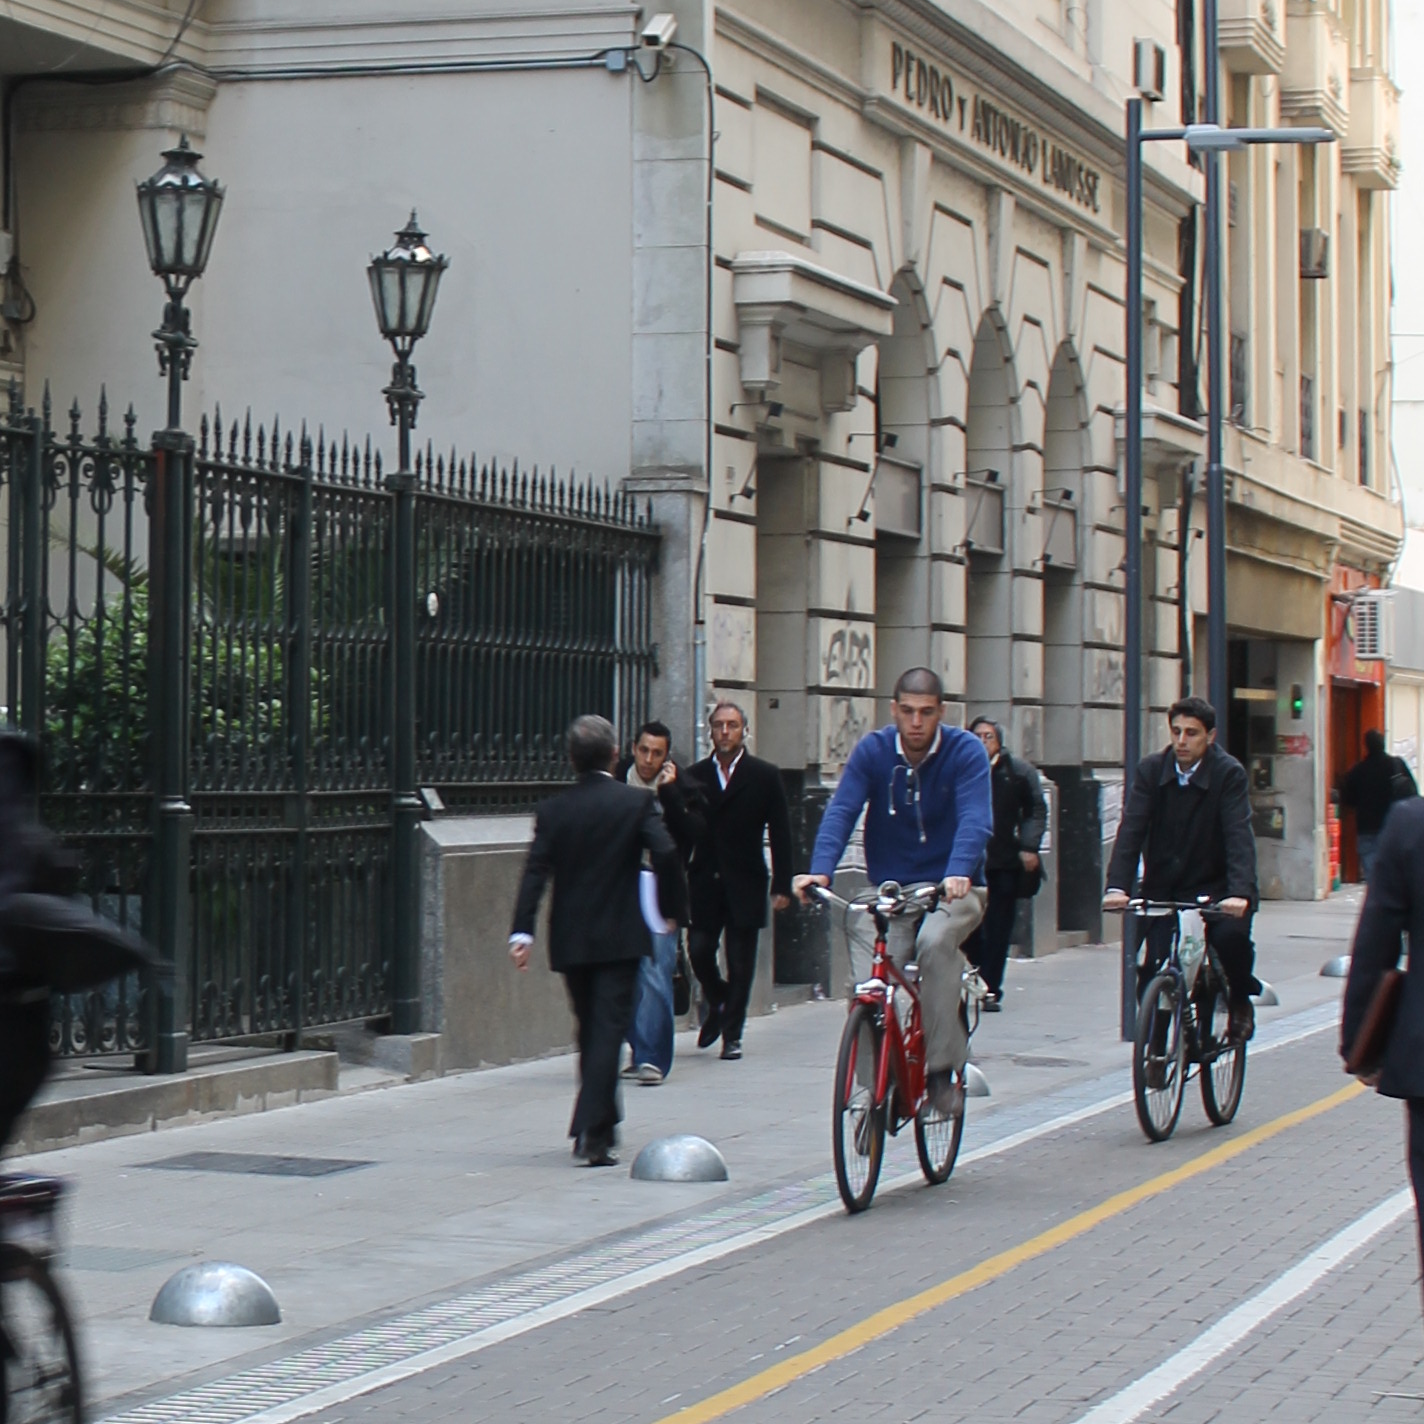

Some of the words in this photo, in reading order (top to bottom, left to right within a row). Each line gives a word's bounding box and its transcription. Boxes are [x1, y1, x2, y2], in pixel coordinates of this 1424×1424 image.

[891, 41, 954, 122] PEDRO
[971, 94, 1038, 175] ANTONIO
[1042, 139, 1101, 214] LANUSSE
